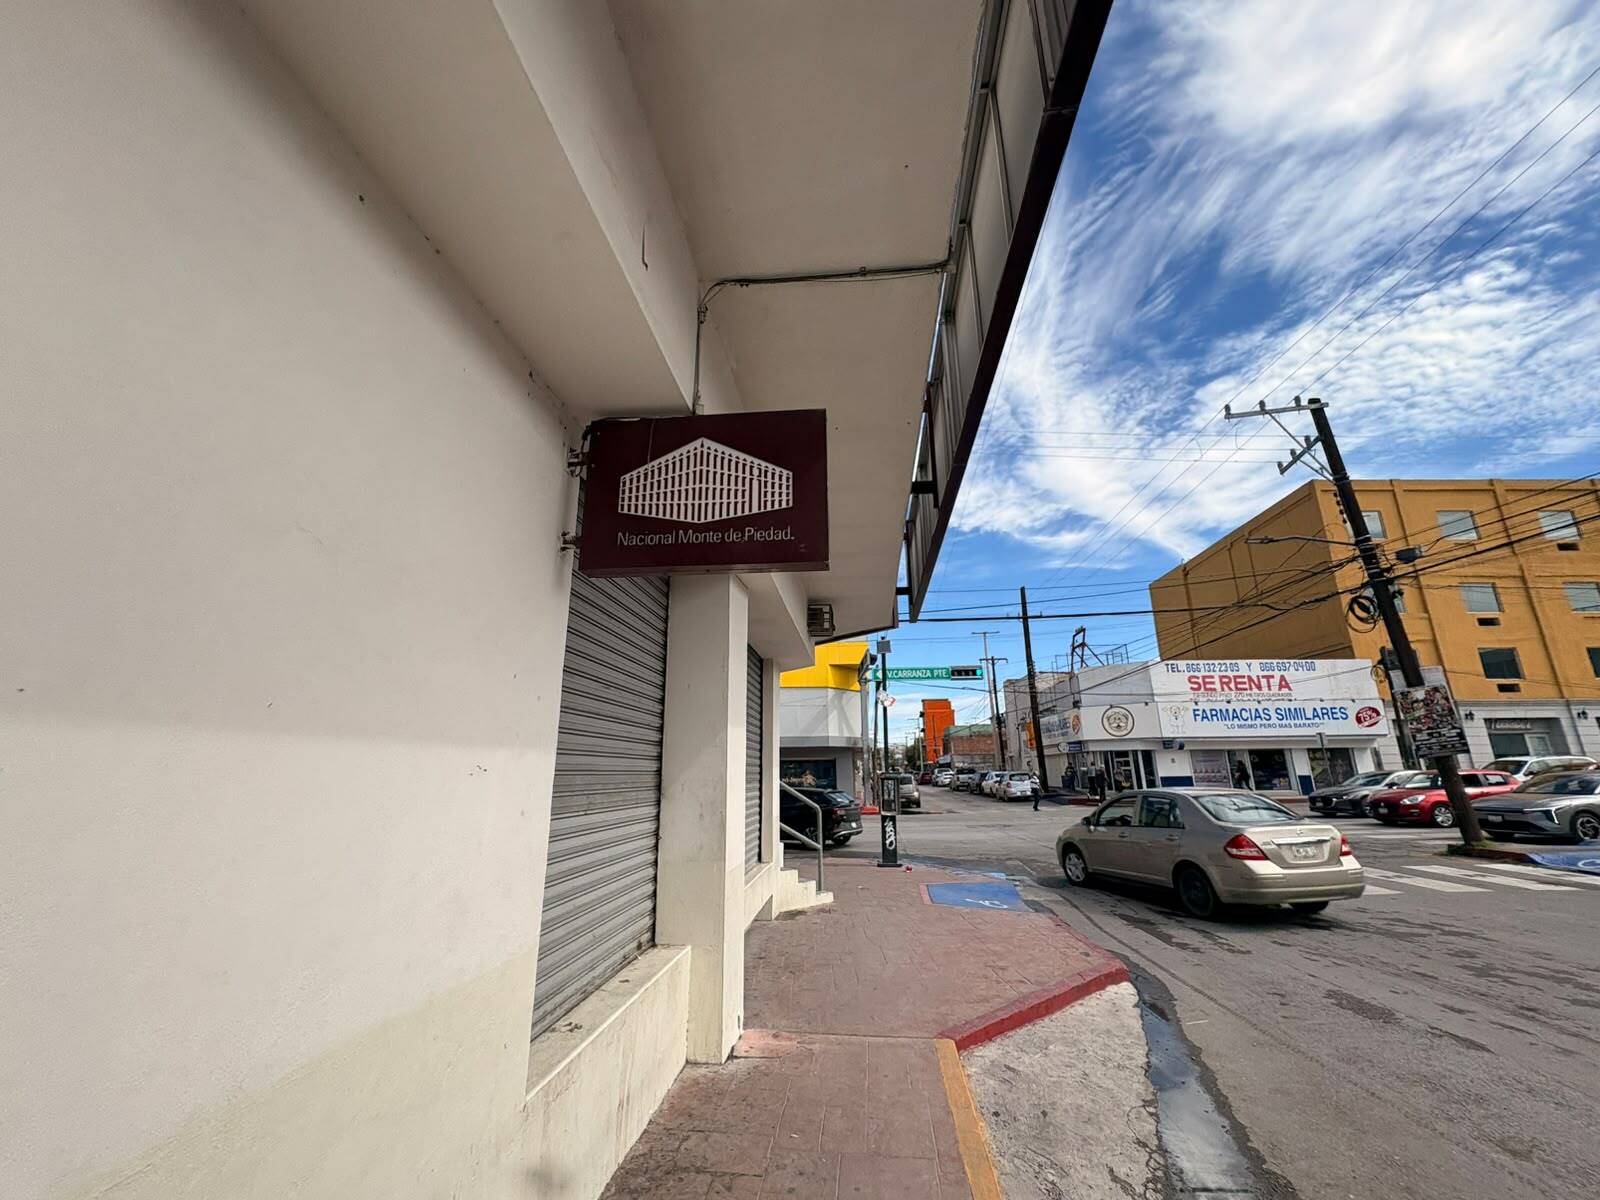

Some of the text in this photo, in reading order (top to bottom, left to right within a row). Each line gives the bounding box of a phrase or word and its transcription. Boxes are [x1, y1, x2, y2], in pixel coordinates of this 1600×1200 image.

[617, 530, 675, 546] Nacional
[678, 529, 722, 544] Monte
[724, 528, 742, 542] de
[887, 669, 949, 678] V.CARRANZA PTE.
[1165, 663, 1185, 673] TEL.
[1245, 662, 1253, 671] Y
[1187, 674, 1293, 692] SE RENTA
[1193, 706, 1349, 722] FARMACIAS SIMILARES
[1358, 710, 1377, 722] 75%
